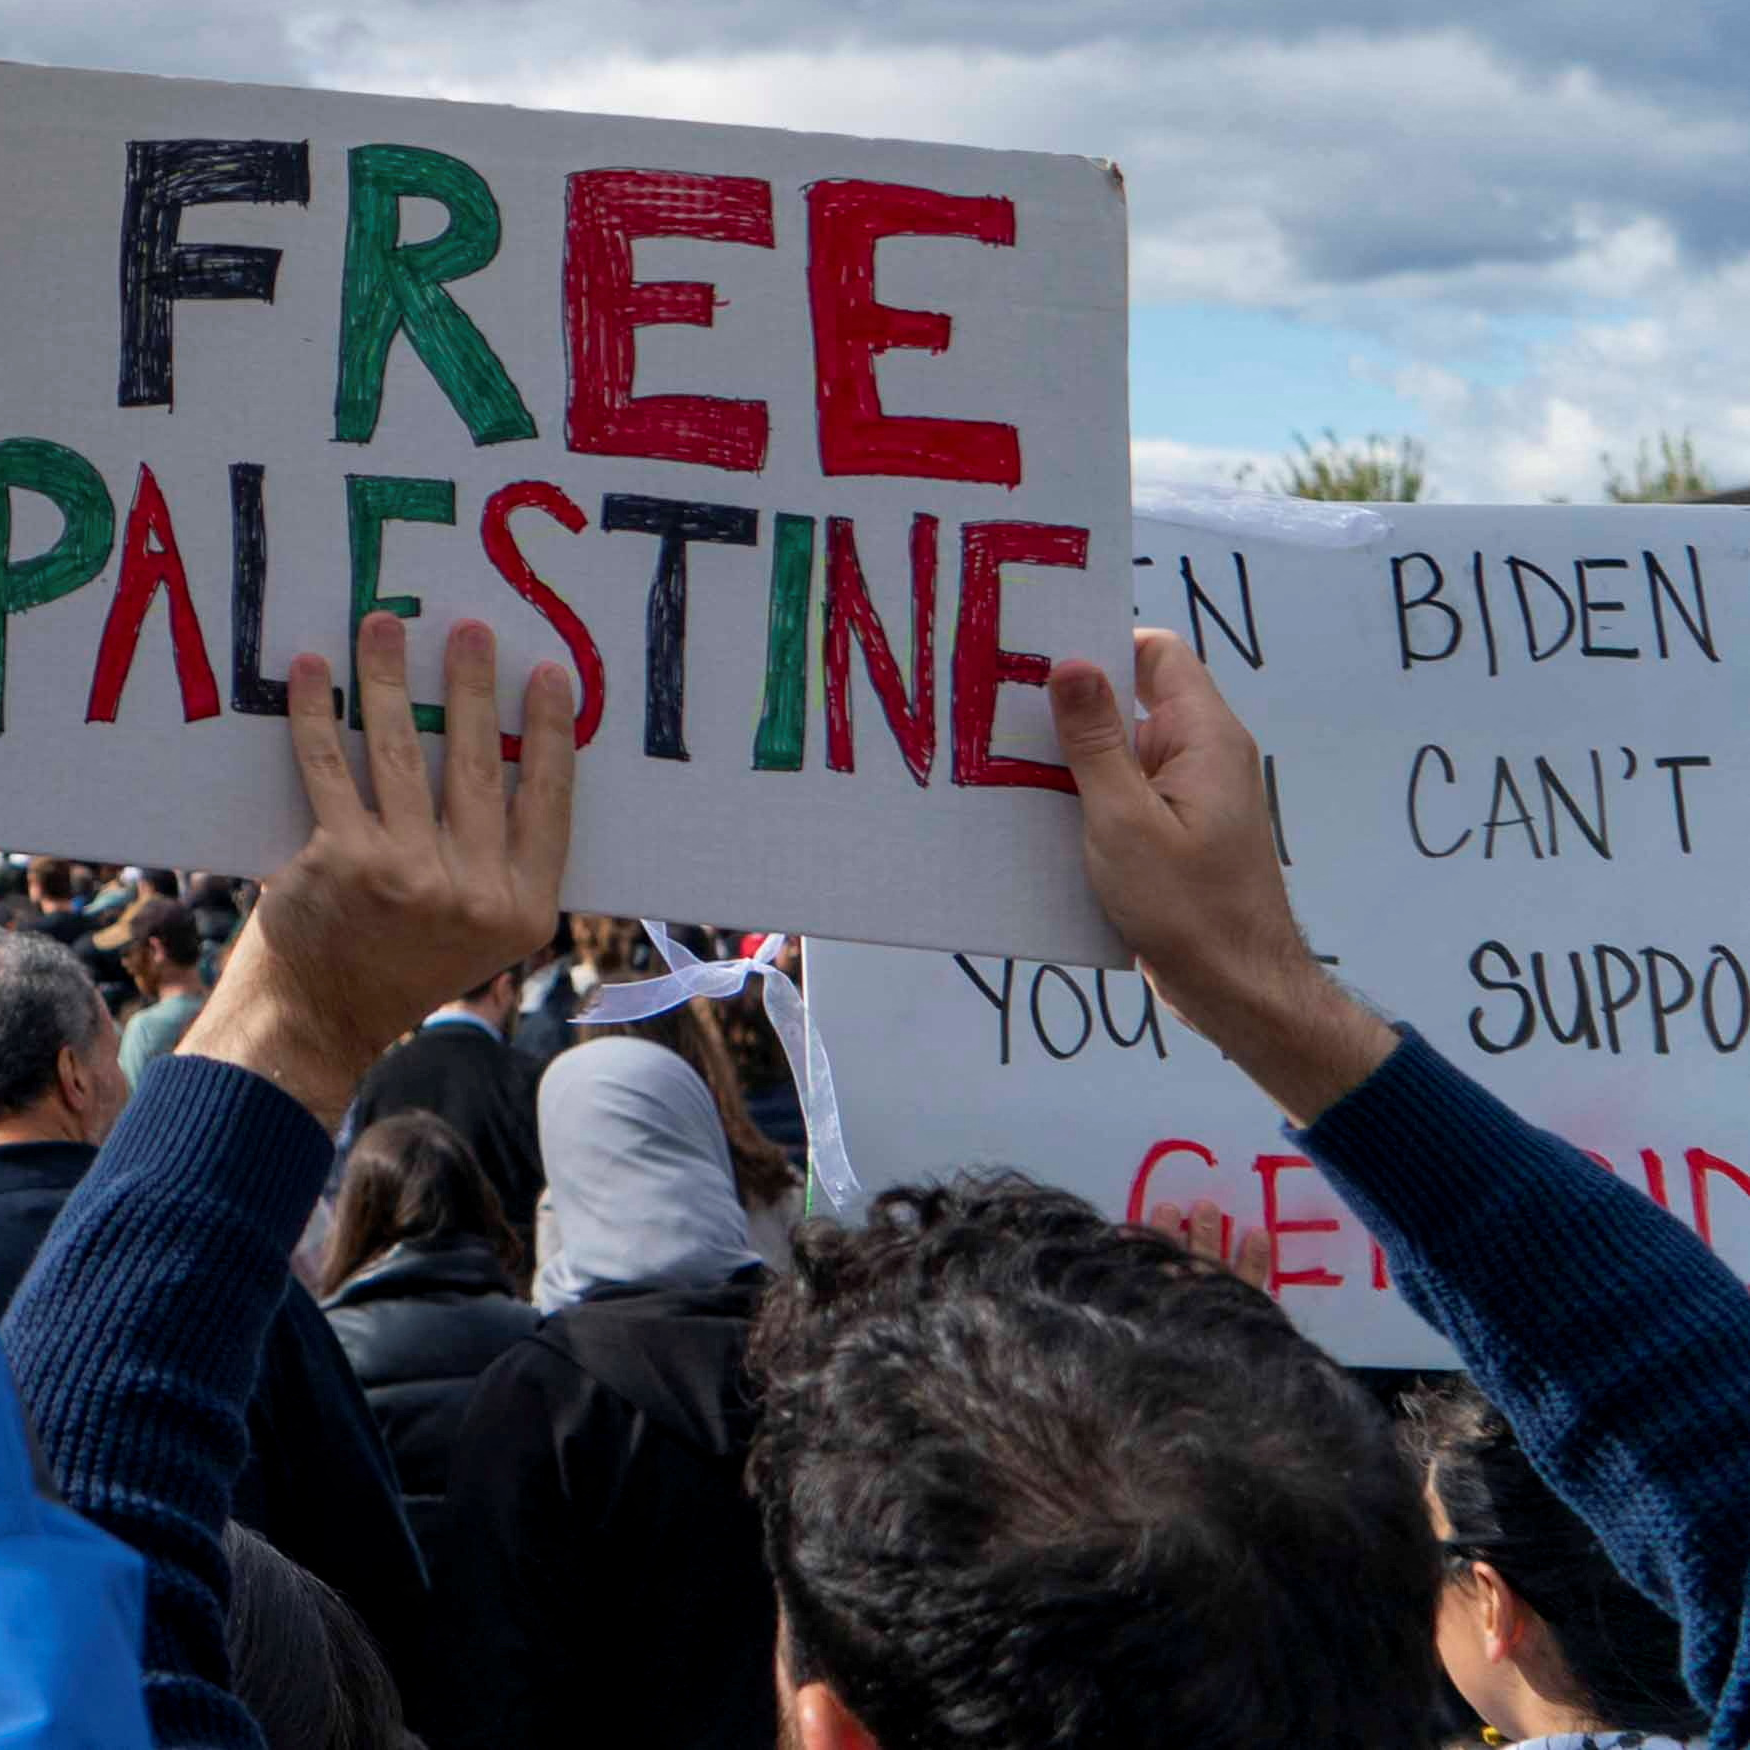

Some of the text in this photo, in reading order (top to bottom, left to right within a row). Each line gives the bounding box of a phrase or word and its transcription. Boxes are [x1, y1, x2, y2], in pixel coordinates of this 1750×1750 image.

[117, 137, 1023, 491] FREE
[1390, 544, 1720, 677] BIDEN
[1407, 744, 1711, 860] CAN'T
